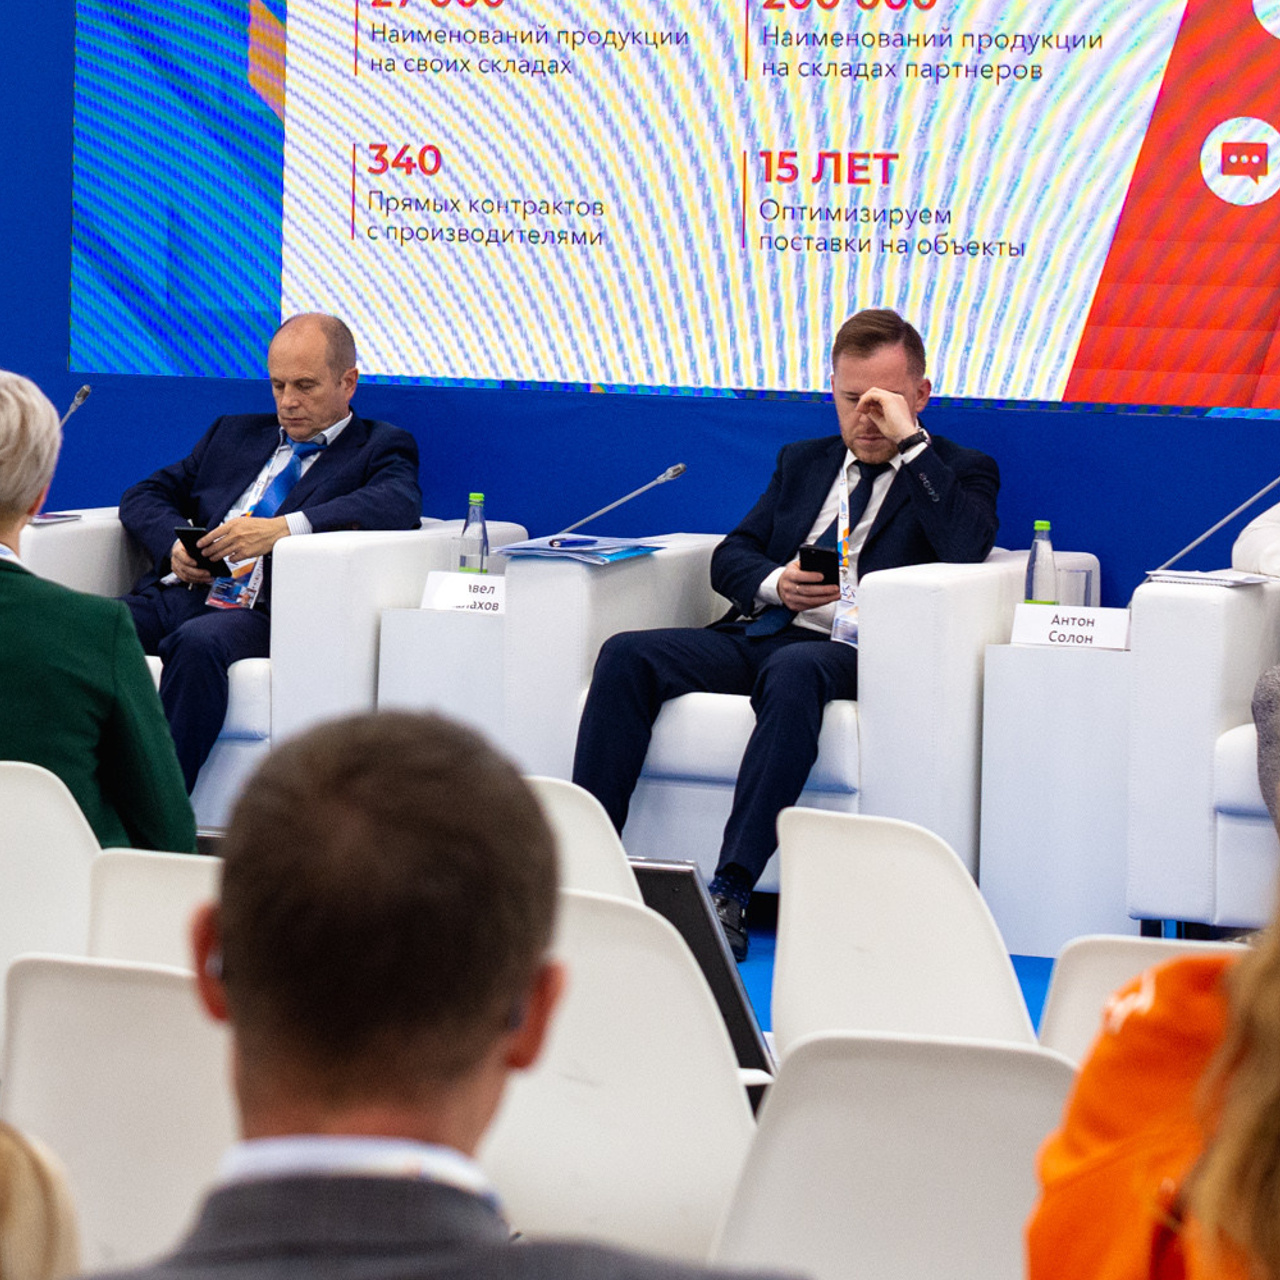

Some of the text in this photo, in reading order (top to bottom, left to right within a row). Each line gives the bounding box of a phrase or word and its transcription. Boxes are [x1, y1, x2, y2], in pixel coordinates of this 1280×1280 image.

[370, 23, 690, 51] Наименований продукции
[762, 26, 1103, 55] Наименований продукции
[370, 58, 573, 76] на своих складах
[762, 62, 1043, 85] на складах партнеров
[367, 143, 442, 176] 340
[759, 151, 900, 185] 15 ЛЕТ
[367, 191, 604, 219] Прямых контрактов
[759, 199, 952, 229] Оптимизируем
[367, 225, 603, 246] с производителями
[759, 233, 1026, 257] поставки на объекты
[1051, 614, 1096, 627] Антон
[1048, 630, 1094, 644] Солон
